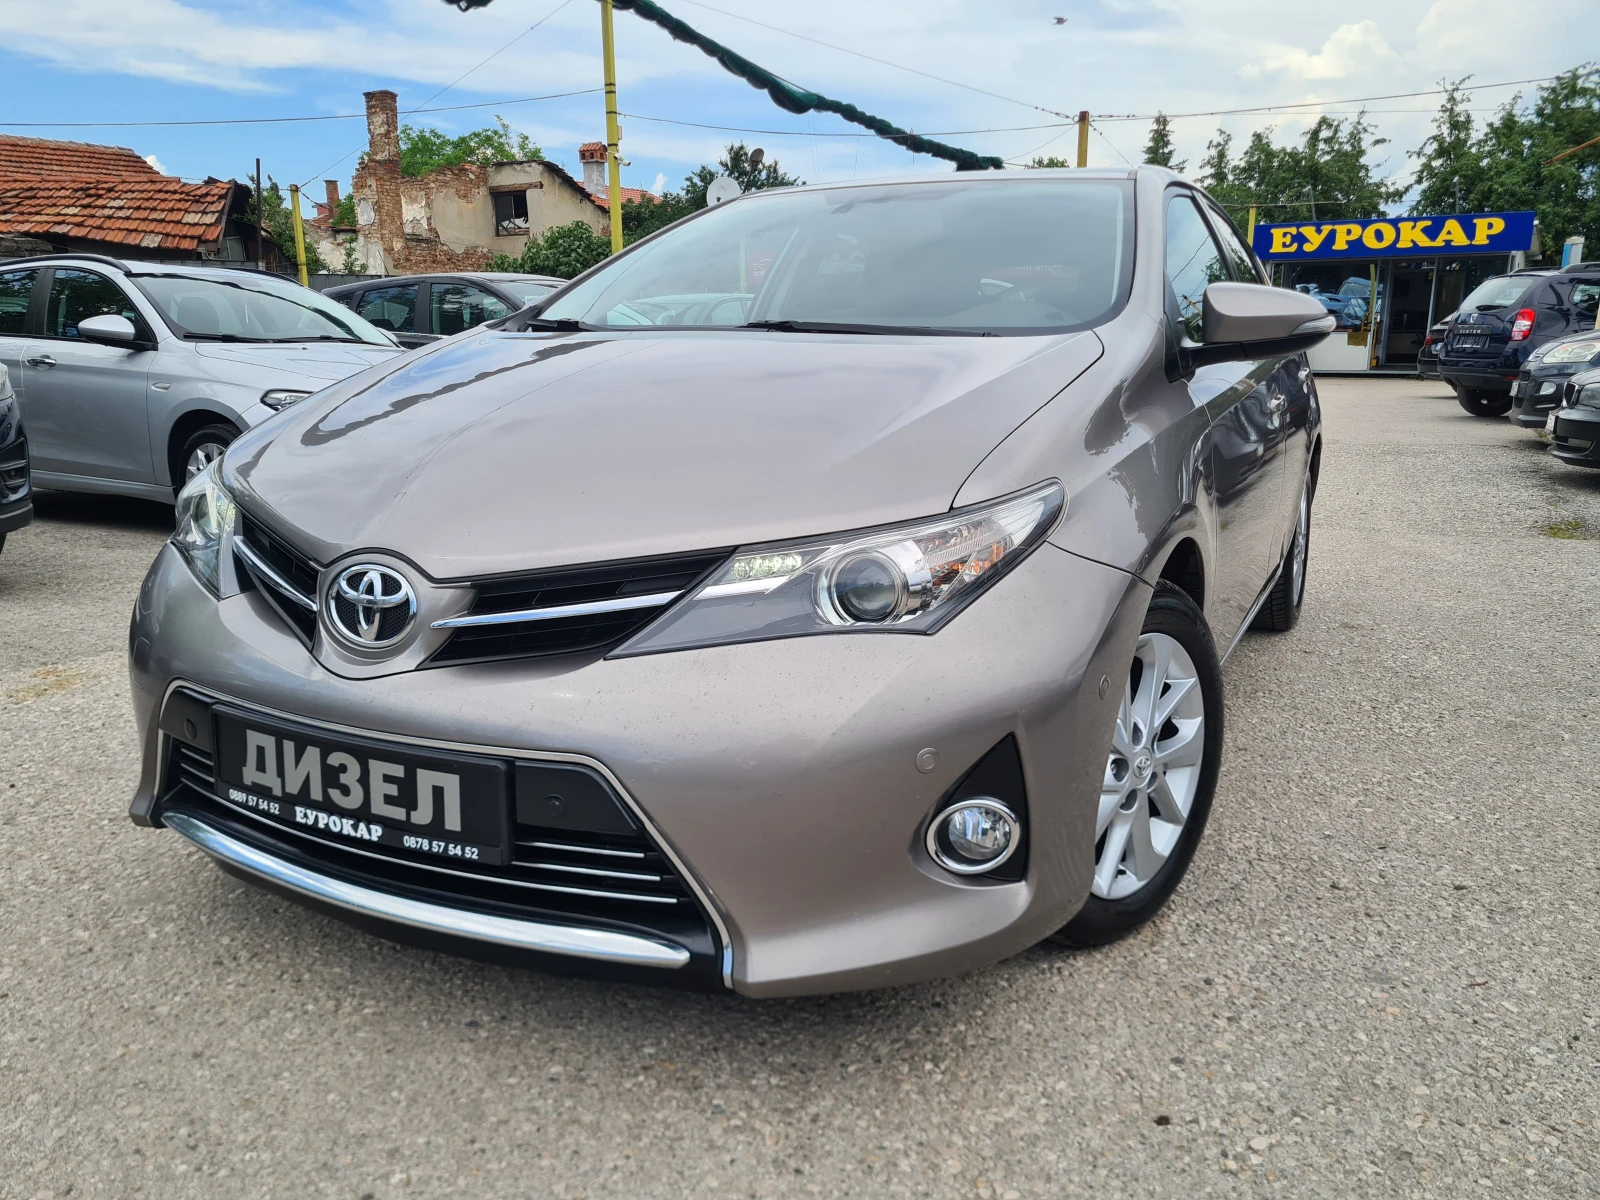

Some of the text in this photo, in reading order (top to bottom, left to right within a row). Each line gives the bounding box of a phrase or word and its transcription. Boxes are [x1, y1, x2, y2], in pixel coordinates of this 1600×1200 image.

[1269, 217, 1506, 253] ЕУРОКАР
[242, 728, 462, 832] ДИЗЕЛ
[229, 788, 280, 815] 0889 57 54 52
[294, 806, 383, 842] ЕУРОКАР
[403, 835, 479, 860] 0878 57 54 52
